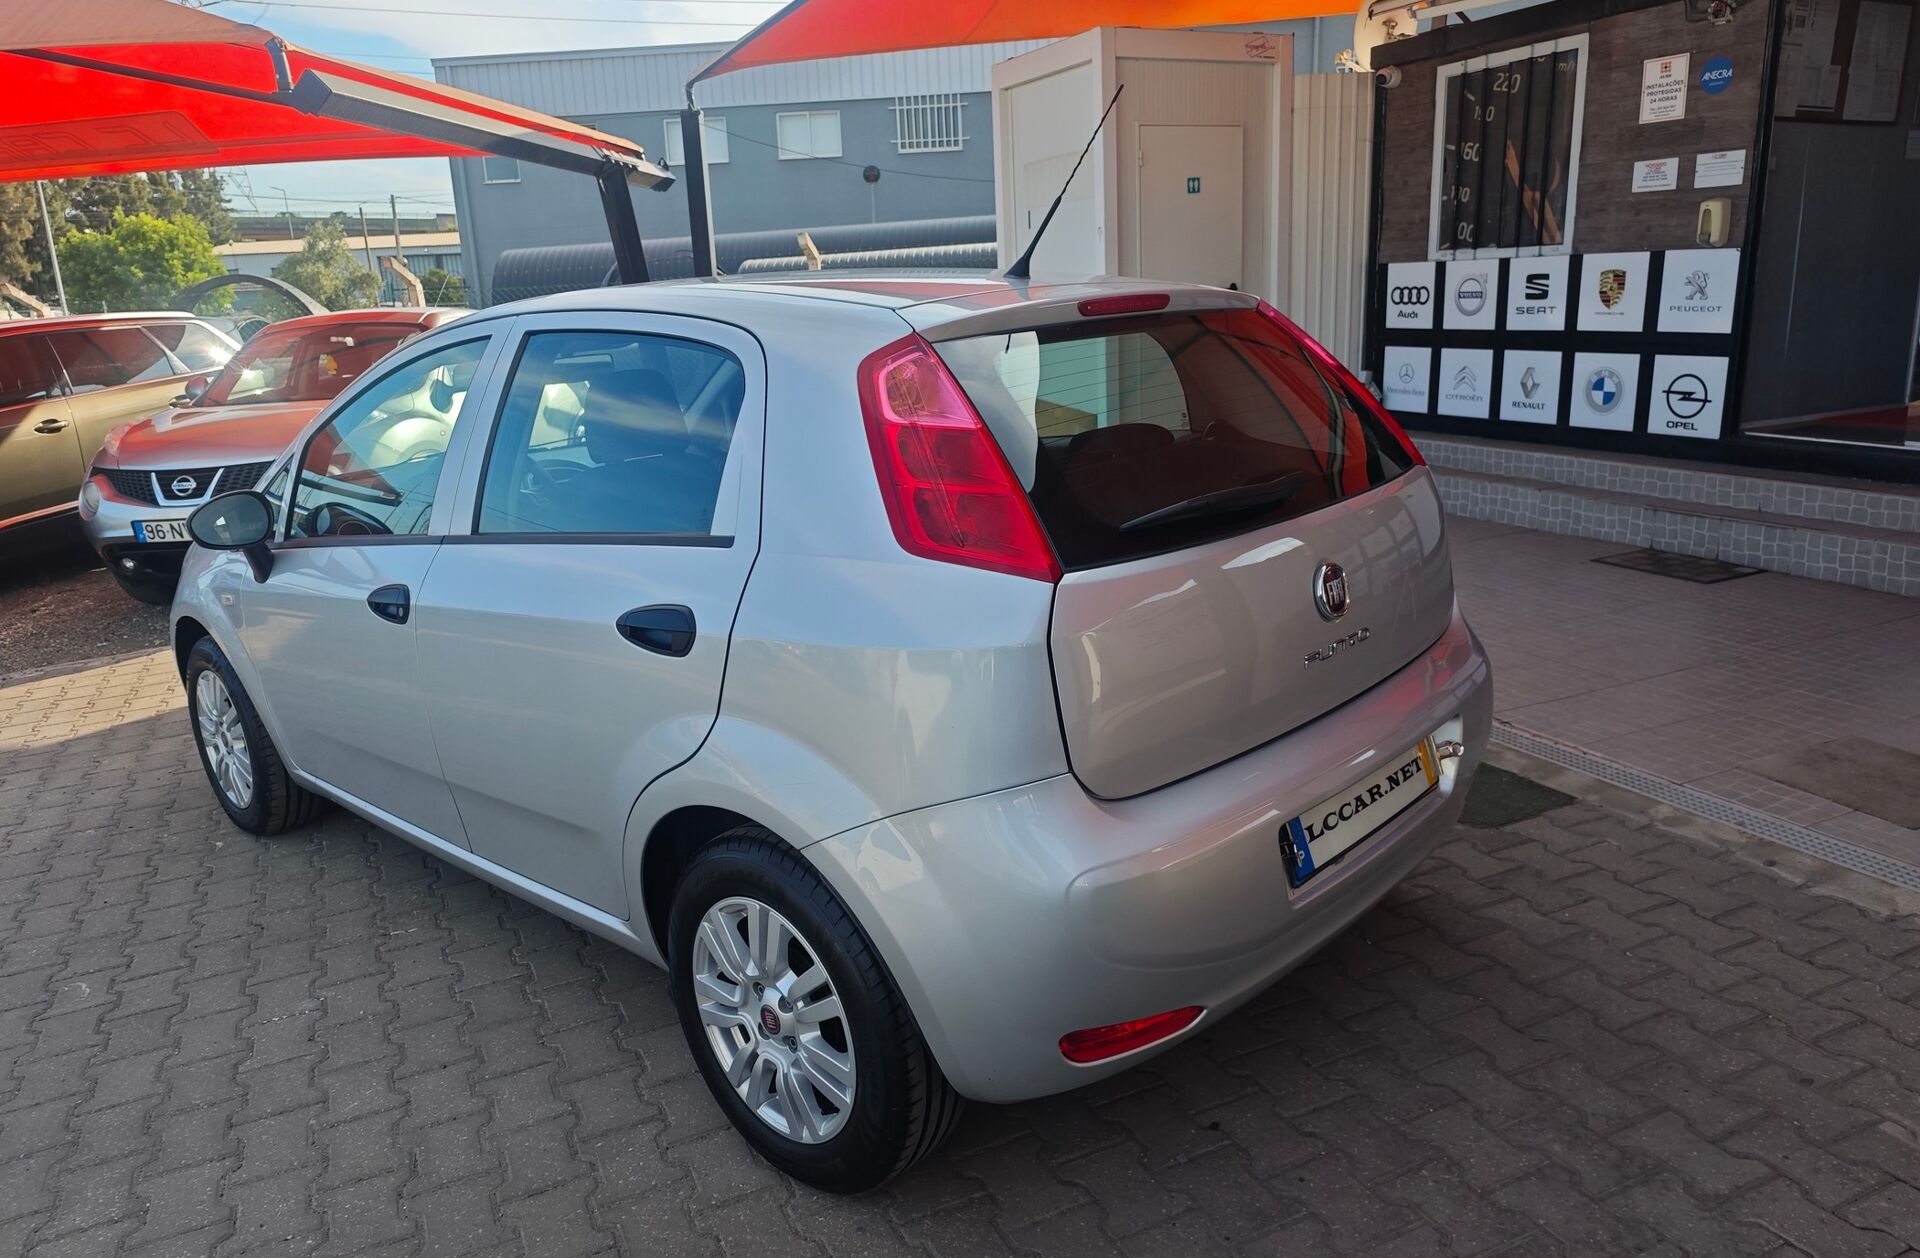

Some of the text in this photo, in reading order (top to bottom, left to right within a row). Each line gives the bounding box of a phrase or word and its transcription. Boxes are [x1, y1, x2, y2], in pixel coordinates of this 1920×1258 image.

[1702, 68, 1732, 81] ANECRA
[1646, 79, 1684, 90] INSTALAÇÕES
[1646, 88, 1682, 97] PROTEGIDAS
[1657, 95, 1678, 103] HORAS
[1458, 291, 1483, 299] VOLVO
[1515, 306, 1557, 315] SEAT
[1669, 305, 1723, 313] PEUGEOT
[1397, 310, 1418, 319] Audi
[1511, 401, 1545, 411] RENAULT
[1666, 420, 1698, 431] OPEL
[1304, 627, 1370, 669] PUNTO
[1304, 756, 1423, 843] LCCAR.NET
